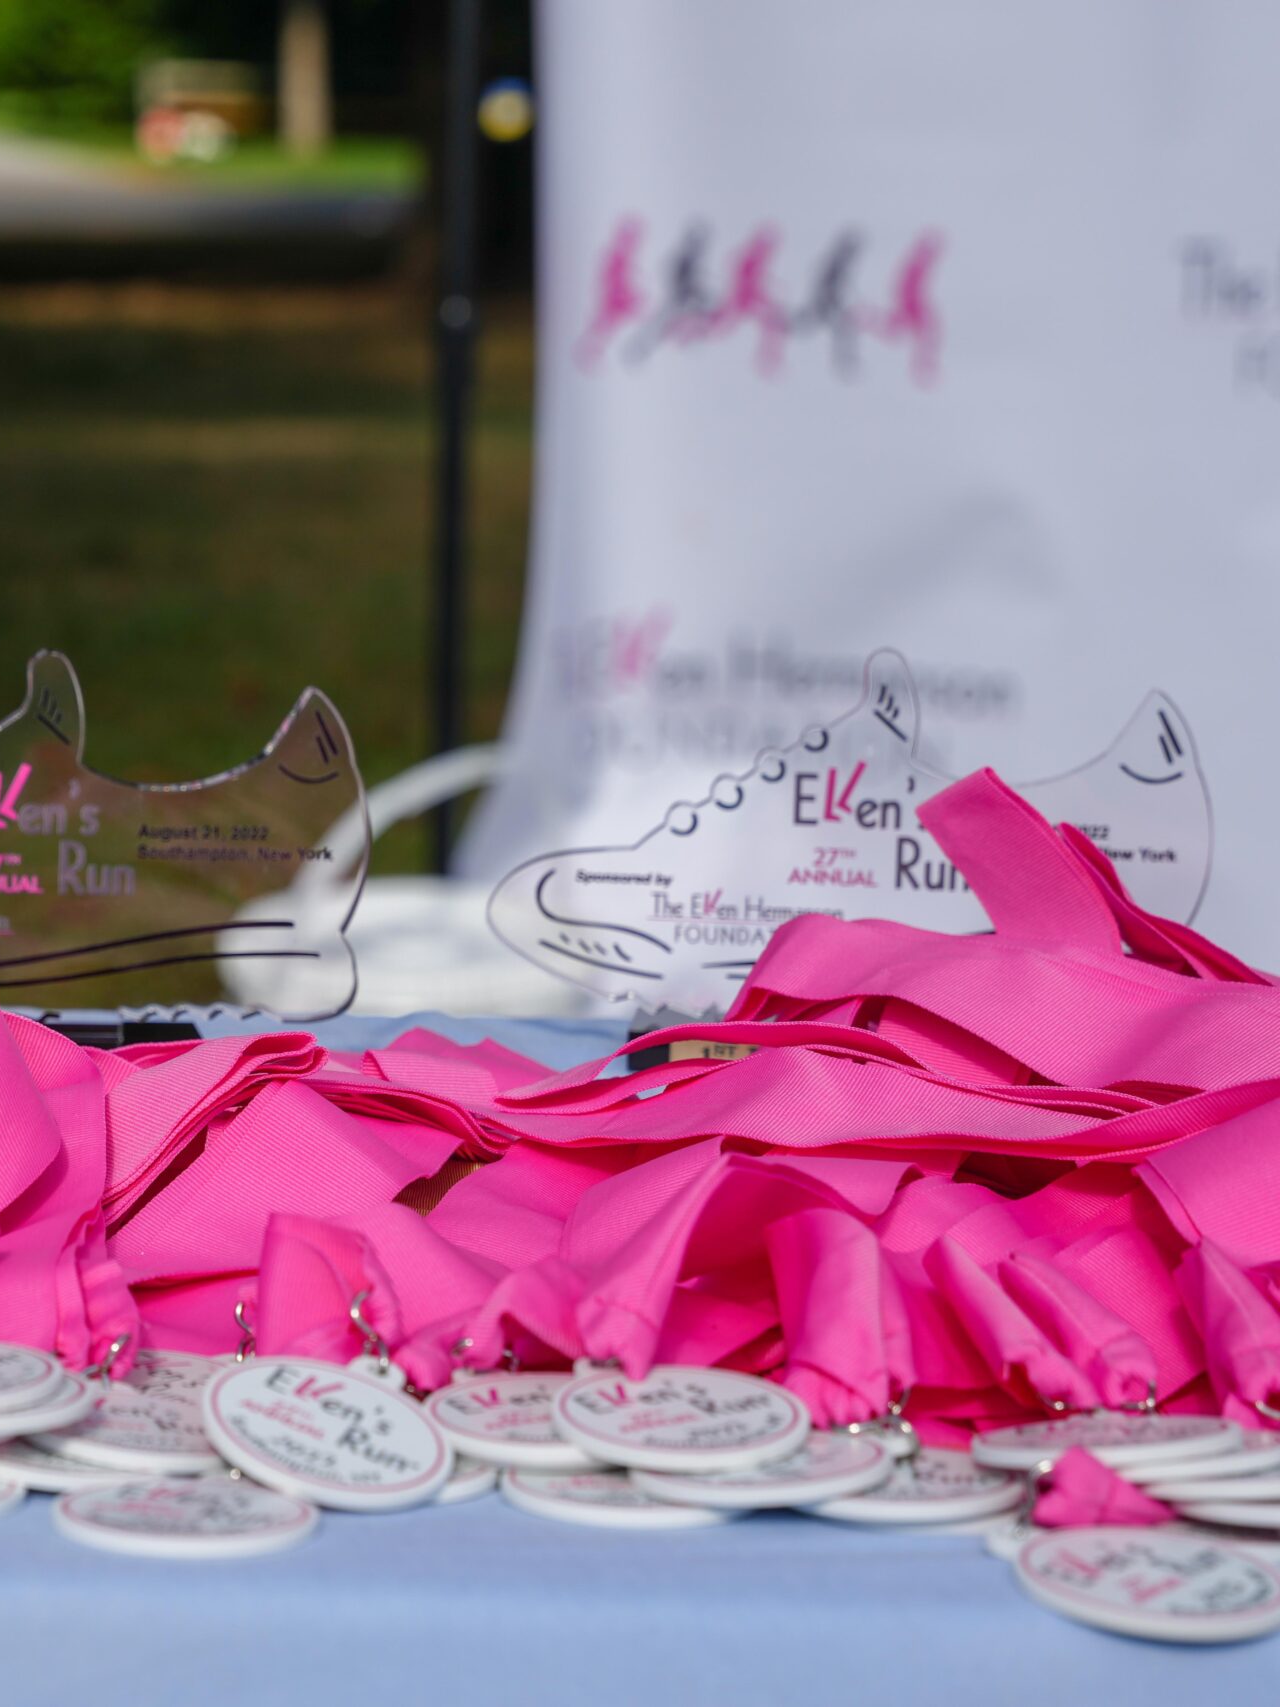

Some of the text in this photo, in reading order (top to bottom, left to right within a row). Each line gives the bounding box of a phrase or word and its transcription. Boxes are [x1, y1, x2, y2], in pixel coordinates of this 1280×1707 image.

[793, 761, 927, 831] Ellen'
[138, 823, 197, 841] August
[231, 825, 270, 841] 2022
[258, 846, 293, 862] New
[297, 847, 333, 862] York
[1138, 847, 1177, 863] York
[58, 840, 137, 898] Run
[575, 868, 672, 888] Sponsored by
[786, 867, 878, 888] ANNUAL
[650, 890, 683, 918] The
